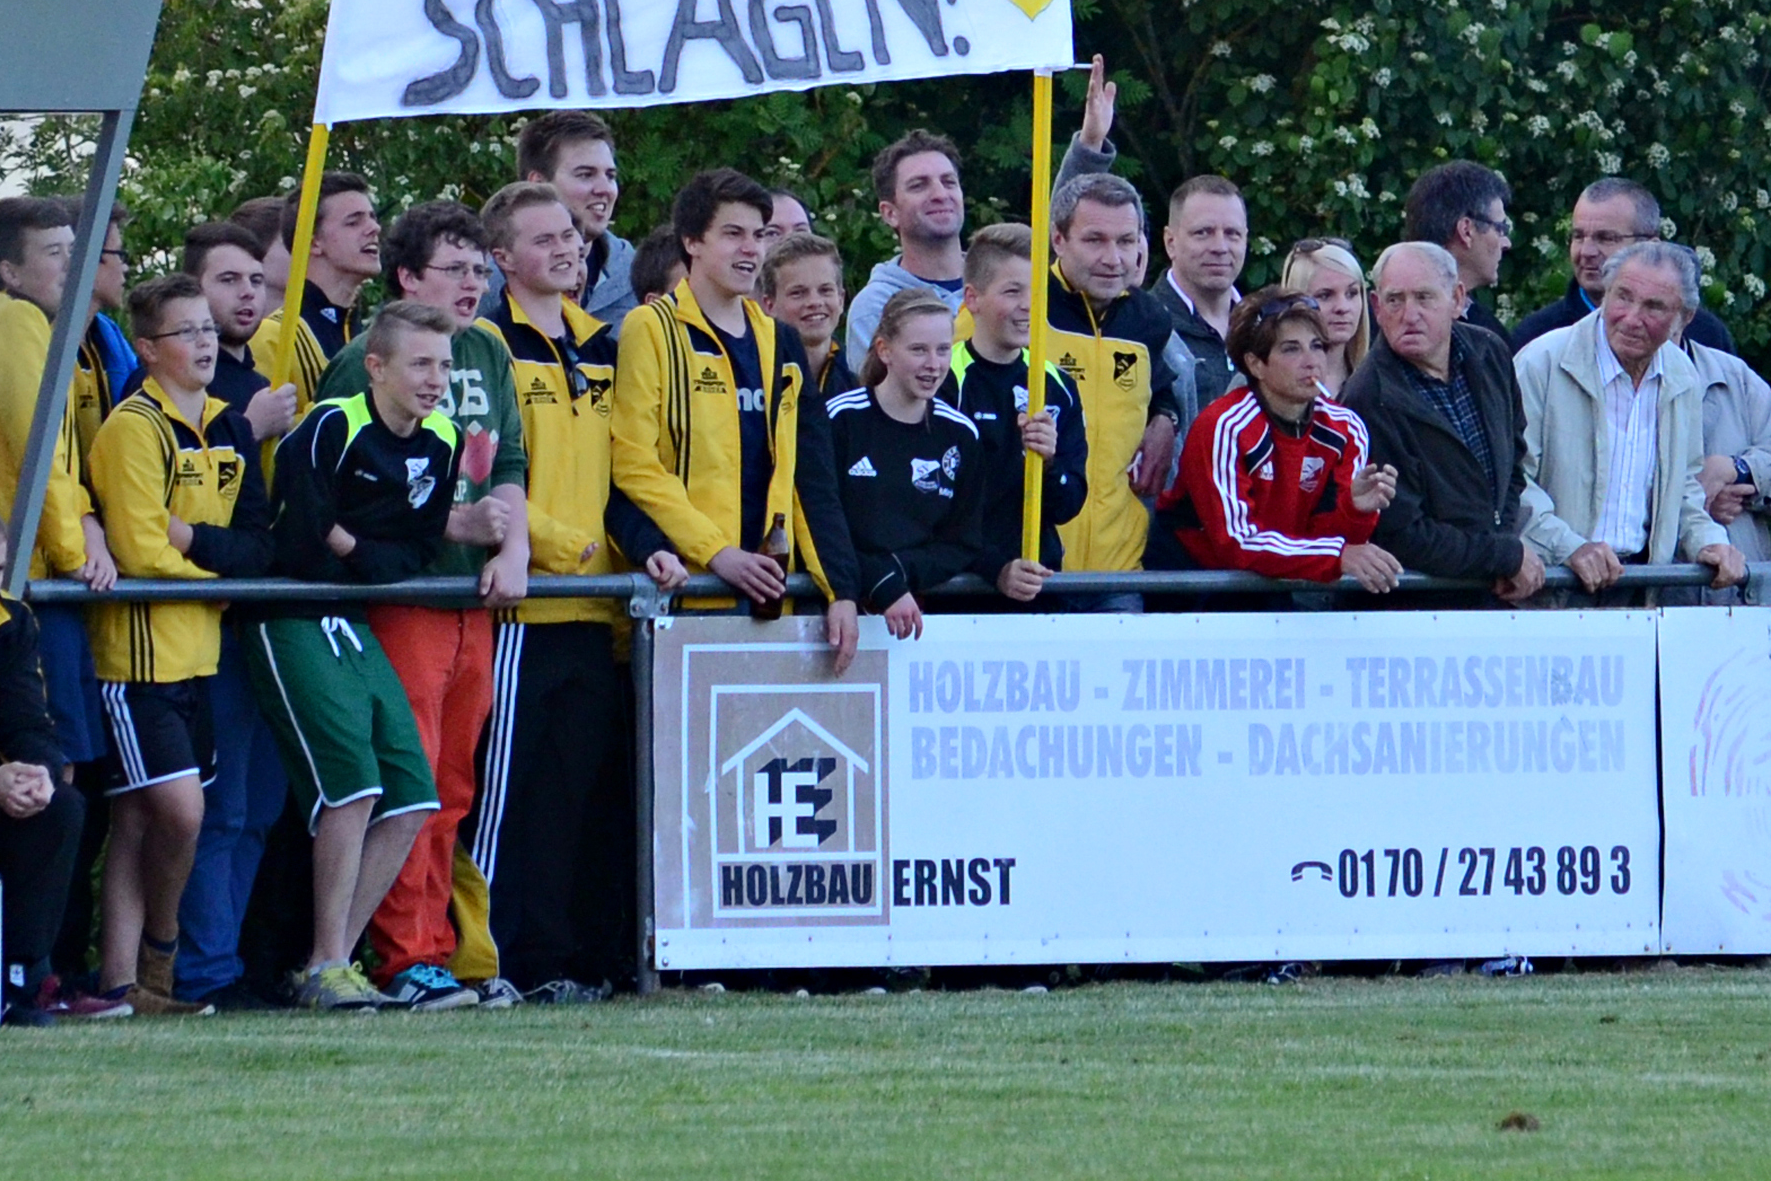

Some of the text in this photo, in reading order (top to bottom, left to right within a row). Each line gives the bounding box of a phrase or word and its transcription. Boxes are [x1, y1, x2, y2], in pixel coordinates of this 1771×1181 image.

[909, 660, 1080, 714] HOLZBAU
[1122, 658, 1306, 711] ZIMMEREI
[1345, 655, 1626, 709] TERRASSENBAU
[911, 723, 1203, 779] BEDACHUNGEN
[1248, 719, 1627, 776] DACHSANIERUNGEN
[721, 857, 1016, 908] HOLZBAU ERNST
